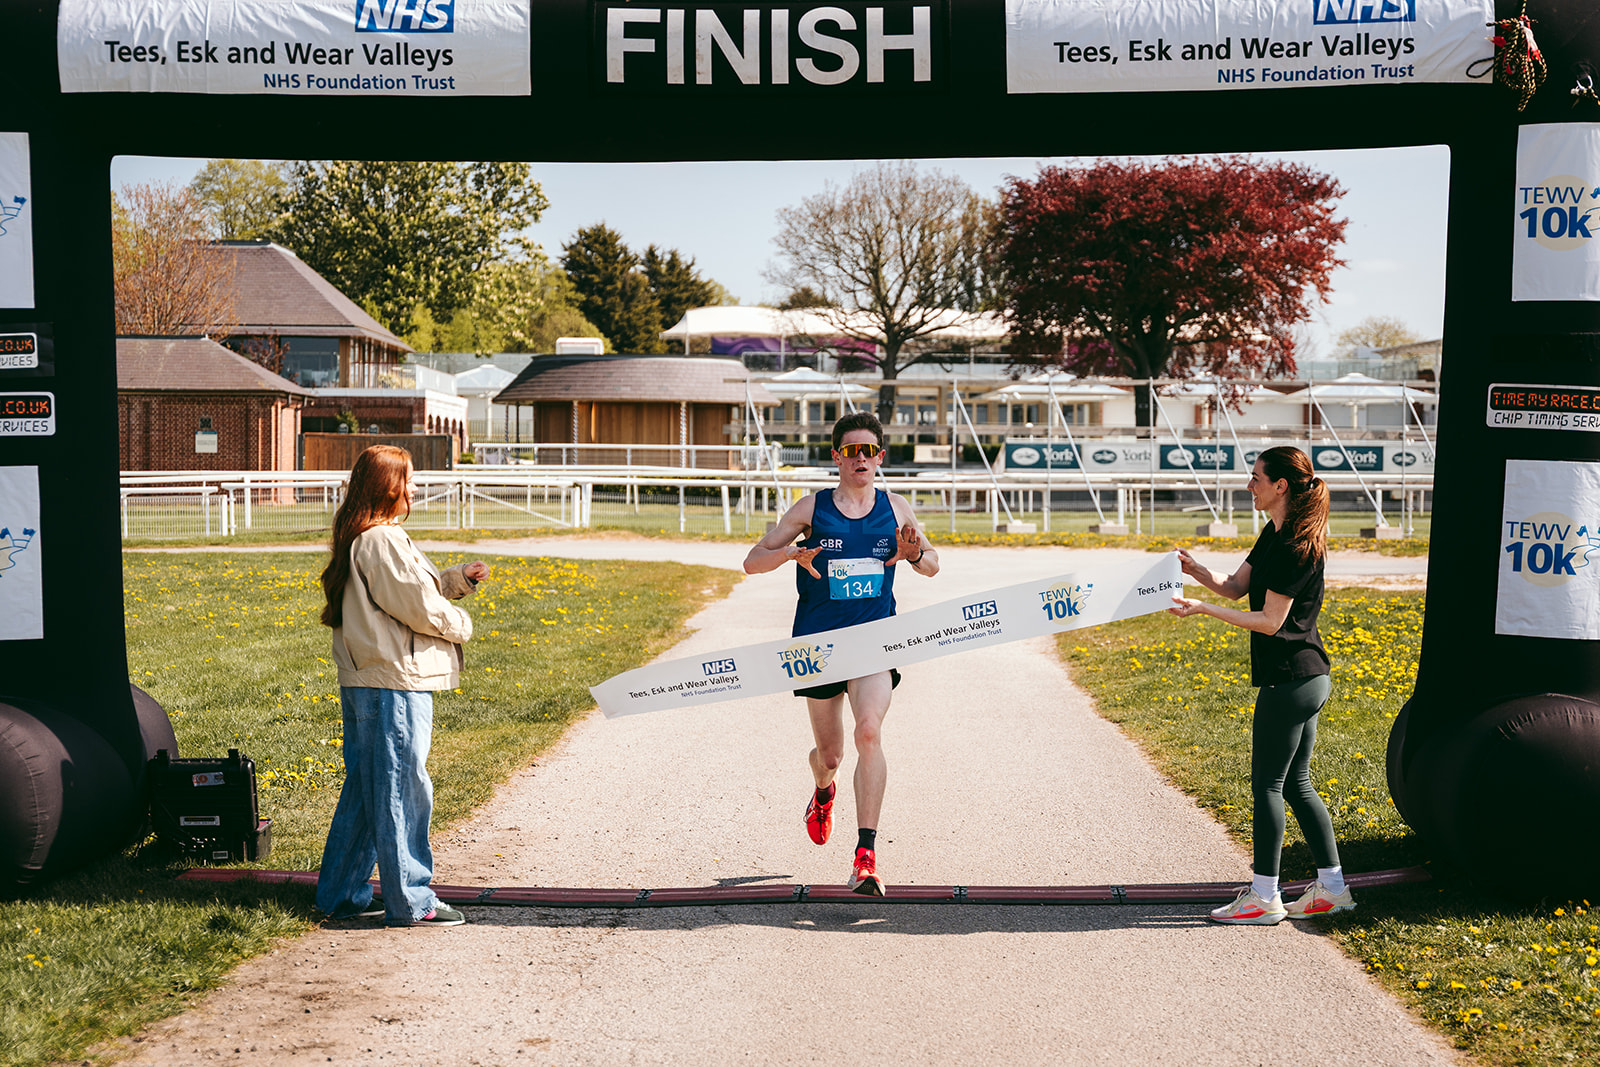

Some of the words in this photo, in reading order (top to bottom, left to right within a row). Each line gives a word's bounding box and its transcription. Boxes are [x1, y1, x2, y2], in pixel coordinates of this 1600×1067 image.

[357, 0, 450, 30] NHS
[607, 6, 931, 85] FINISH
[1054, 41, 1118, 65] Tees,
[1129, 38, 1172, 61] Esk
[1181, 37, 1231, 61] and
[1241, 37, 1312, 59] Wear
[1321, 33, 1415, 60] Valleys
[104, 41, 166, 65] Tees,
[177, 40, 219, 63] Esk
[227, 41, 275, 64] and
[285, 43, 354, 65] Wear
[362, 42, 454, 72] Valleys
[264, 74, 300, 88] NHS
[307, 74, 406, 90] Foundation
[412, 75, 455, 90] Trust
[1218, 69, 1255, 83] NHS
[1262, 65, 1365, 82] Foundation
[1371, 64, 1414, 78] Trust
[1519, 187, 1585, 204] TEWV
[1520, 206, 1592, 238] 10k
[0, 356, 33, 366] VICES
[0, 400, 49, 414] .CO.UK
[1495, 412, 1523, 424] CHIP
[1528, 413, 1568, 426] TIMING
[1042, 448, 1074, 462] York
[1347, 450, 1377, 464] York
[1506, 521, 1571, 541] TEWV
[819, 538, 843, 549] GBR
[1505, 541, 1577, 575] 10k
[832, 568, 848, 577] 10k
[842, 580, 873, 598] 134
[1038, 586, 1072, 602] TEWV
[1137, 586, 1157, 596] Tees,
[1159, 581, 1173, 591] Esk
[965, 602, 996, 619] NHS
[1042, 598, 1080, 621] 10k
[883, 644, 906, 653] Tees,
[907, 636, 922, 647] Esk
[925, 631, 942, 642] and
[943, 624, 967, 637] Wear
[969, 618, 1001, 631] Valleys
[953, 632, 987, 644] Foundation
[987, 628, 1002, 636] Trust
[777, 647, 811, 661] TEWV
[705, 659, 734, 675] NHS
[781, 657, 822, 678] 10k
[629, 691, 651, 700] Tees,
[651, 686, 666, 696] Esk
[668, 683, 684, 693] and
[685, 679, 708, 689] Wear
[709, 675, 739, 686] Valleys
[695, 686, 726, 696] Foundation
